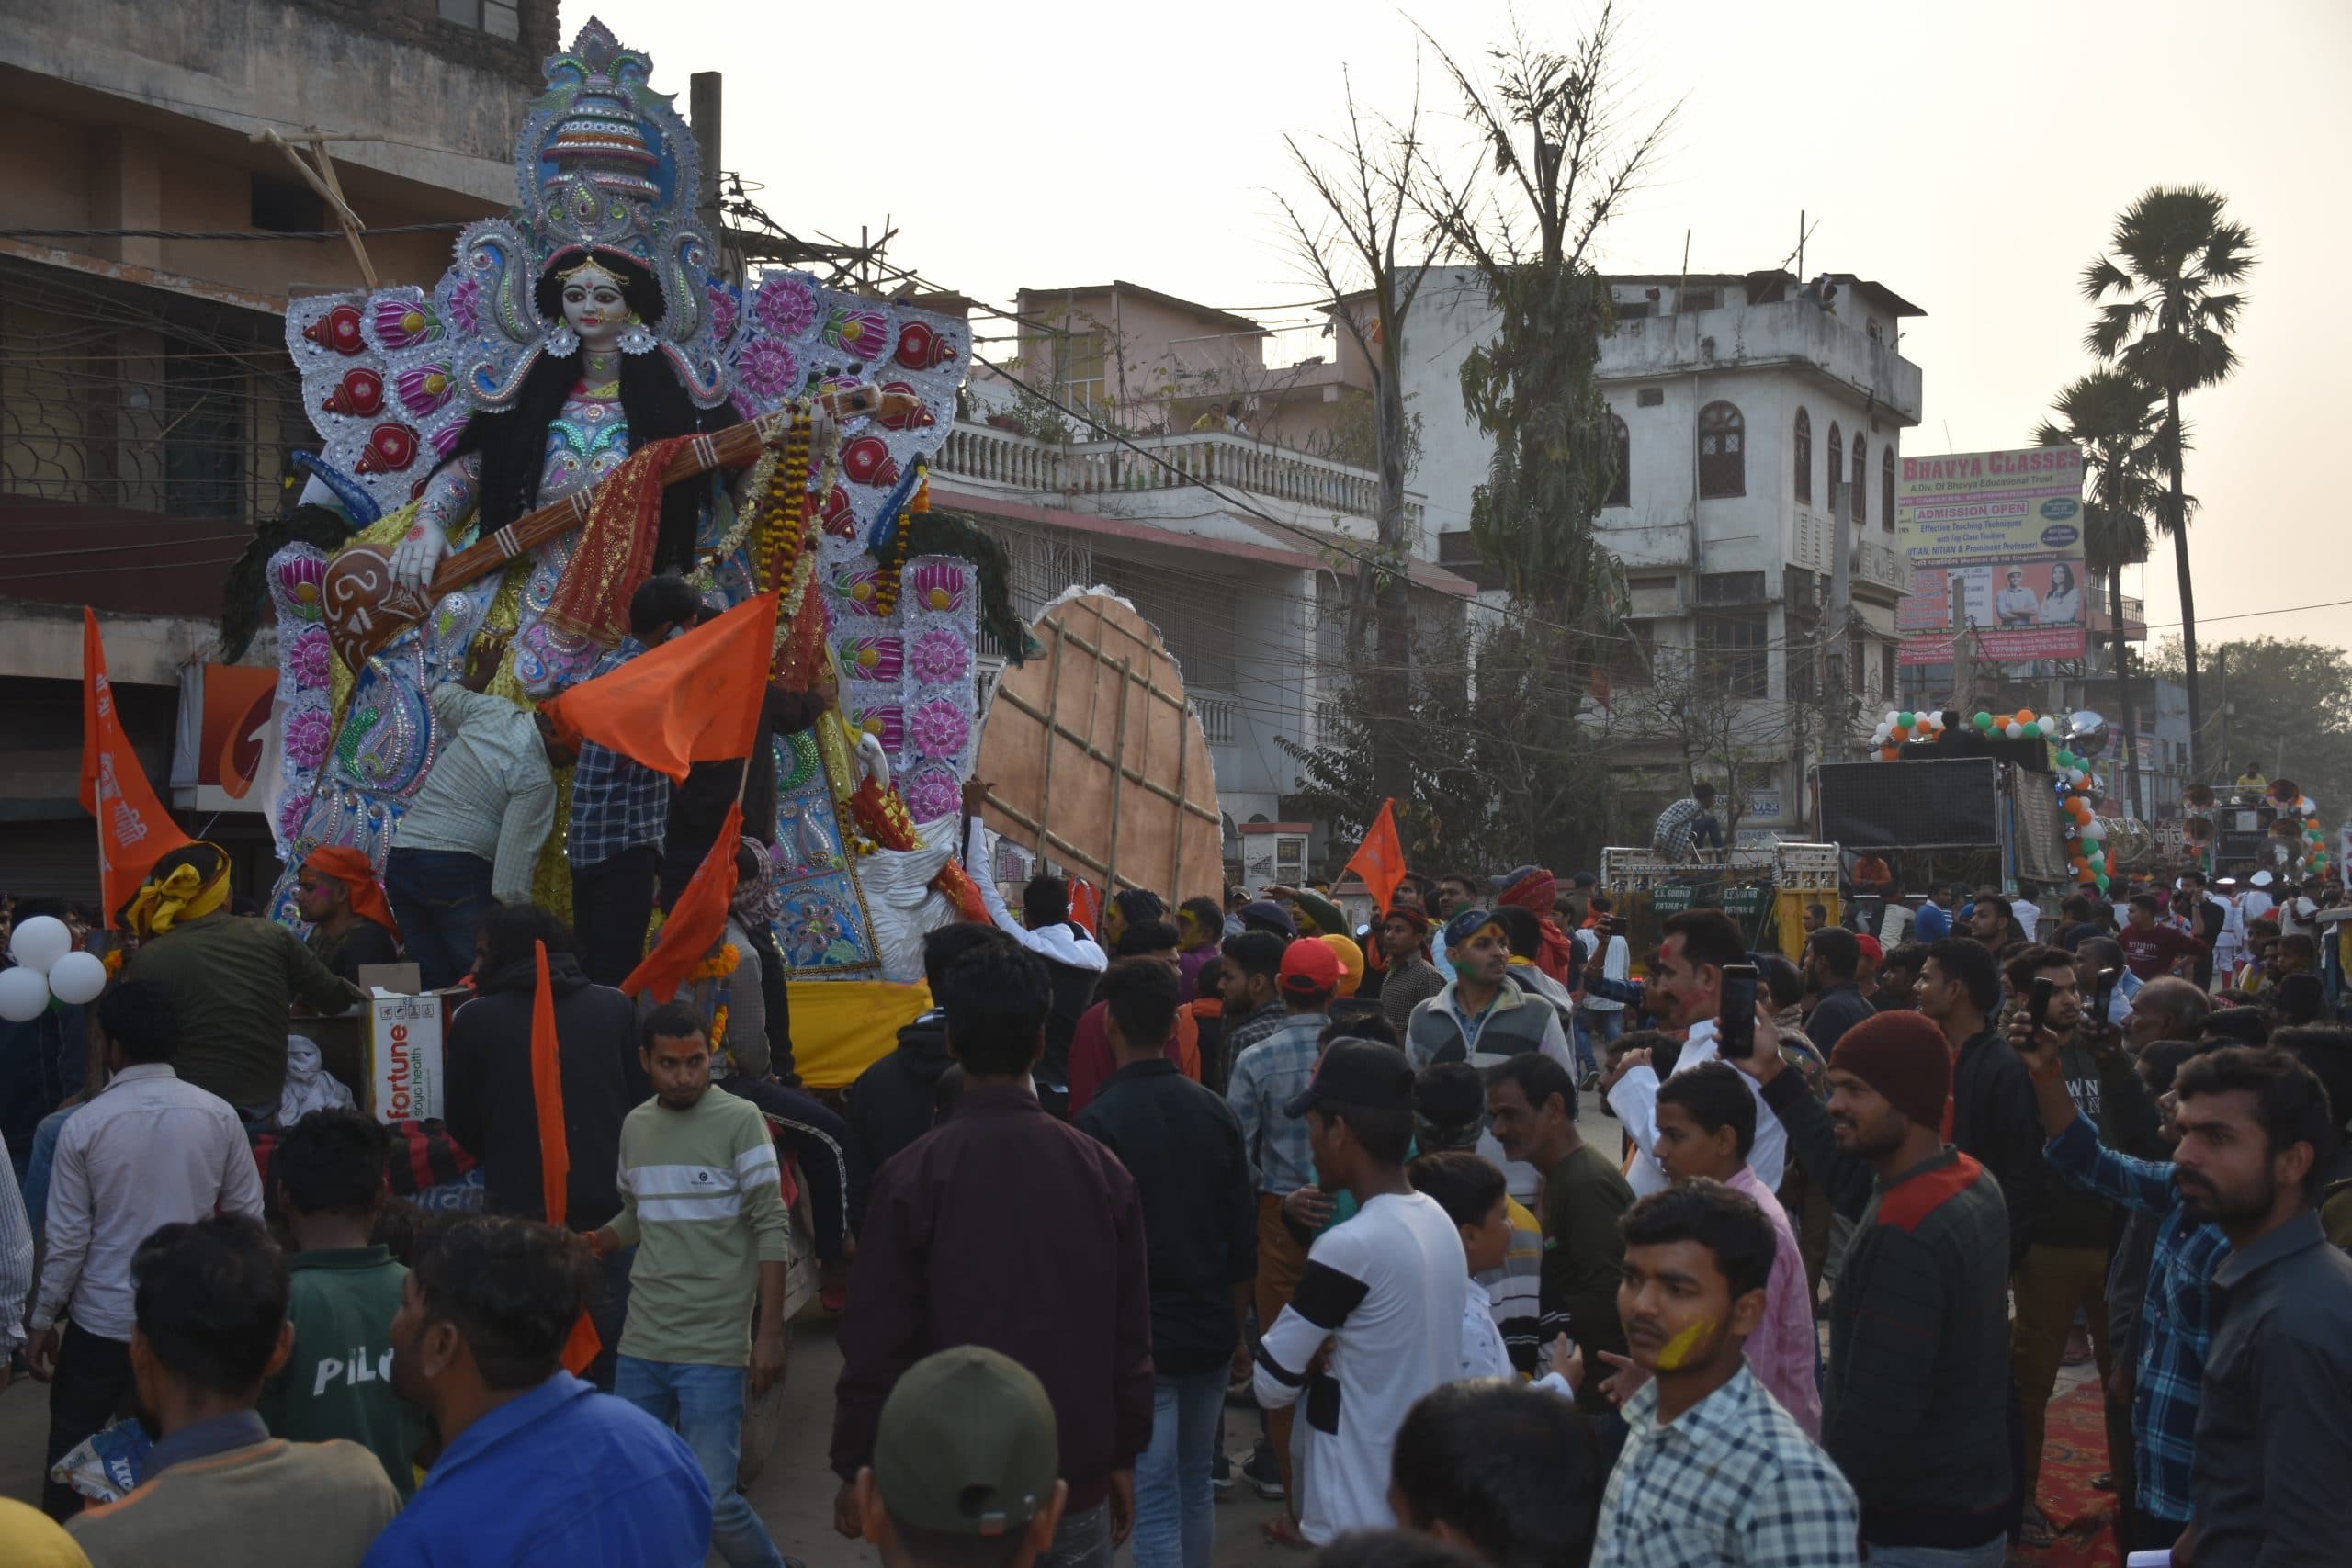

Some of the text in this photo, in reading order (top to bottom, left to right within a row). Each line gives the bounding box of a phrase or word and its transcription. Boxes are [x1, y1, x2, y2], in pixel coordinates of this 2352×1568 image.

[1903, 449, 2081, 480] BHAVYA CLASSES
[1980, 477, 2029, 488] Educational
[2030, 475, 2053, 484] Trust
[1917, 505, 1989, 520] ADMISSION
[1991, 502, 2026, 514] OPEN
[386, 1024, 410, 1120] fortune
[412, 1048, 426, 1117] soya health
